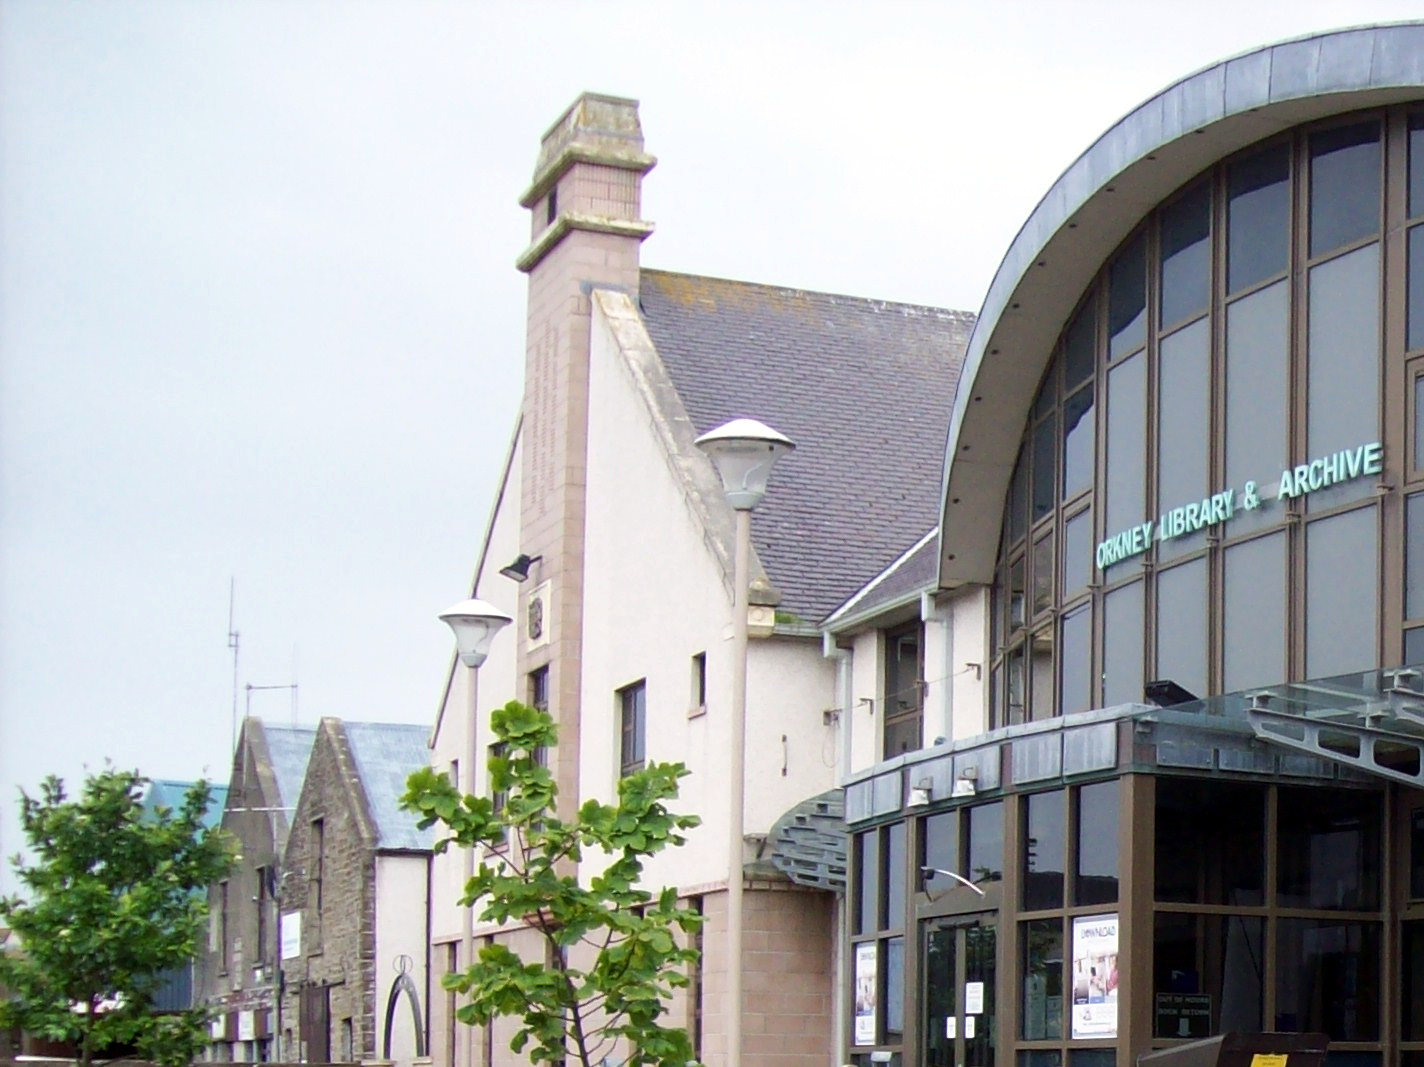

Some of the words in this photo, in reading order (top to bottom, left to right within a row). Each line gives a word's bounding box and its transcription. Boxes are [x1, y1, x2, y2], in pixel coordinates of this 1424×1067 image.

[1096, 520, 1154, 570] ORKNEY
[1160, 488, 1236, 542] LIBRARY
[1243, 480, 1260, 511] &
[1277, 441, 1383, 500] ARCHIVE
